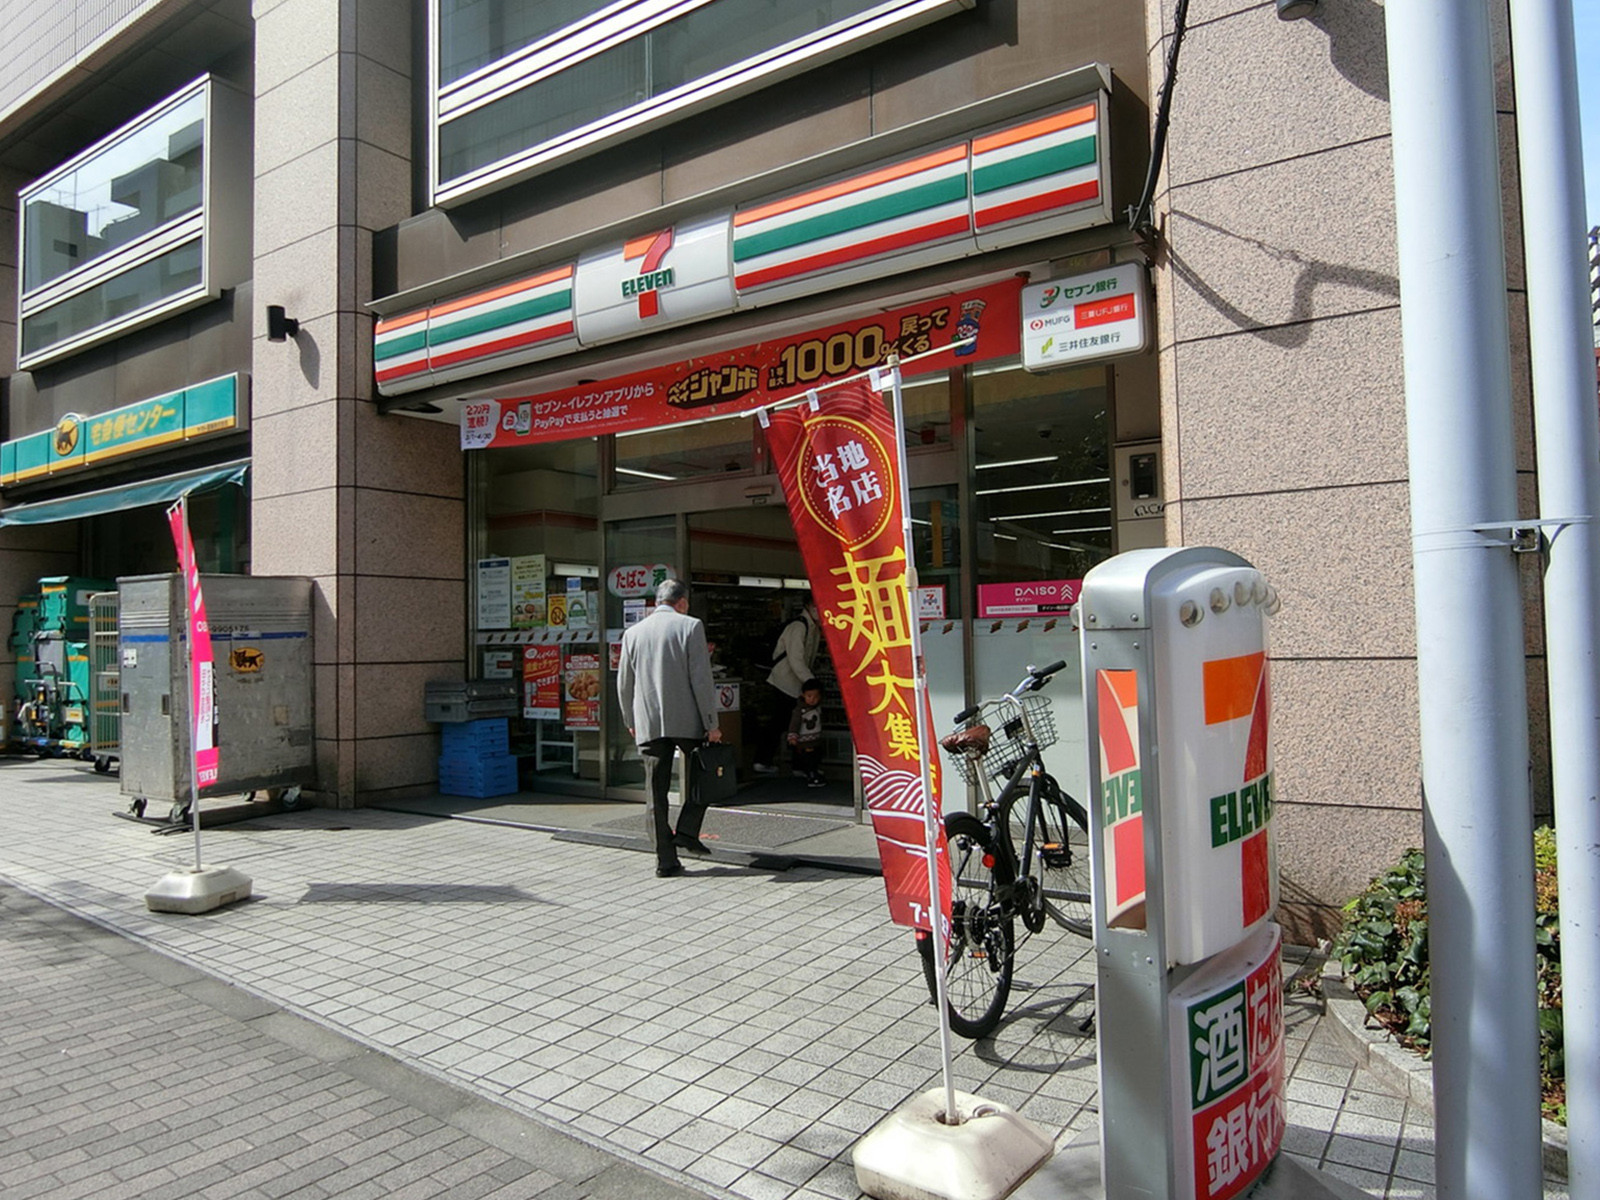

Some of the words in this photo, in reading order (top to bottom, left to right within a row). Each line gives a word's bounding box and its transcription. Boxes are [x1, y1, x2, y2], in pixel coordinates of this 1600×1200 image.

[1064, 278, 1118, 300] セブン銀行
[901, 309, 948, 336] 戻って
[1045, 316, 1071, 327] MUFG
[781, 325, 899, 384] 1000%
[902, 335, 930, 354] くる
[1059, 332, 1121, 353] 三井住友銀行
[534, 382, 655, 415] セブン-イレブンアプリから
[691, 367, 758, 401] ジャンボ
[91, 404, 176, 446] 宅急便センター
[811, 440, 870, 489] 当地
[824, 471, 883, 520] 名店
[615, 570, 648, 590] たばこ
[1014, 586, 1057, 597] DAISO
[1194, 992, 1244, 1102] 酒
